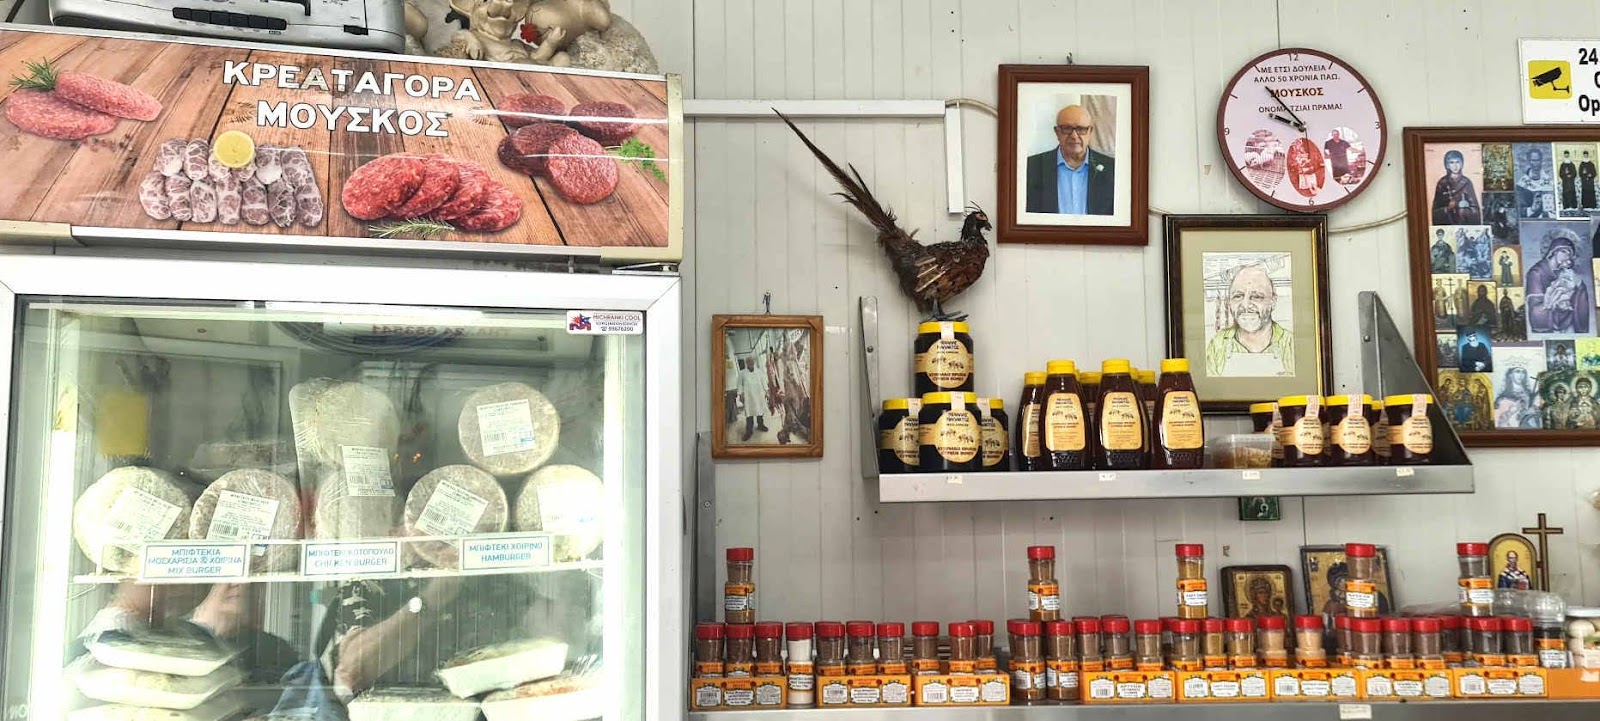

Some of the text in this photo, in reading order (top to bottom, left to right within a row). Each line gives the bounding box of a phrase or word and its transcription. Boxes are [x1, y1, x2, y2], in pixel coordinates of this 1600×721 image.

[1288, 54, 1299, 62] 12
[223, 60, 481, 102] ΚΡΕΑΤΑΓΟΡΑ
[1289, 74, 1318, 82] ΧΡΟΝΙΑ
[1270, 87, 1324, 98] ΜΟΥΣΚΟΣ
[256, 99, 449, 137] ΜΟΥΣΚΟΣ
[1308, 197, 1315, 206] 6
[469, 542, 543, 552] ΜΠΙΦΤΕΚΙ ΧΟΙΡΙΝΟ
[172, 548, 221, 556] ΜΠΙΦΤΕΚΙΑ
[481, 553, 532, 562] HAMBURGER
[314, 558, 388, 568] CHICKEN BURGER
[168, 566, 222, 574] MIX BURGER
